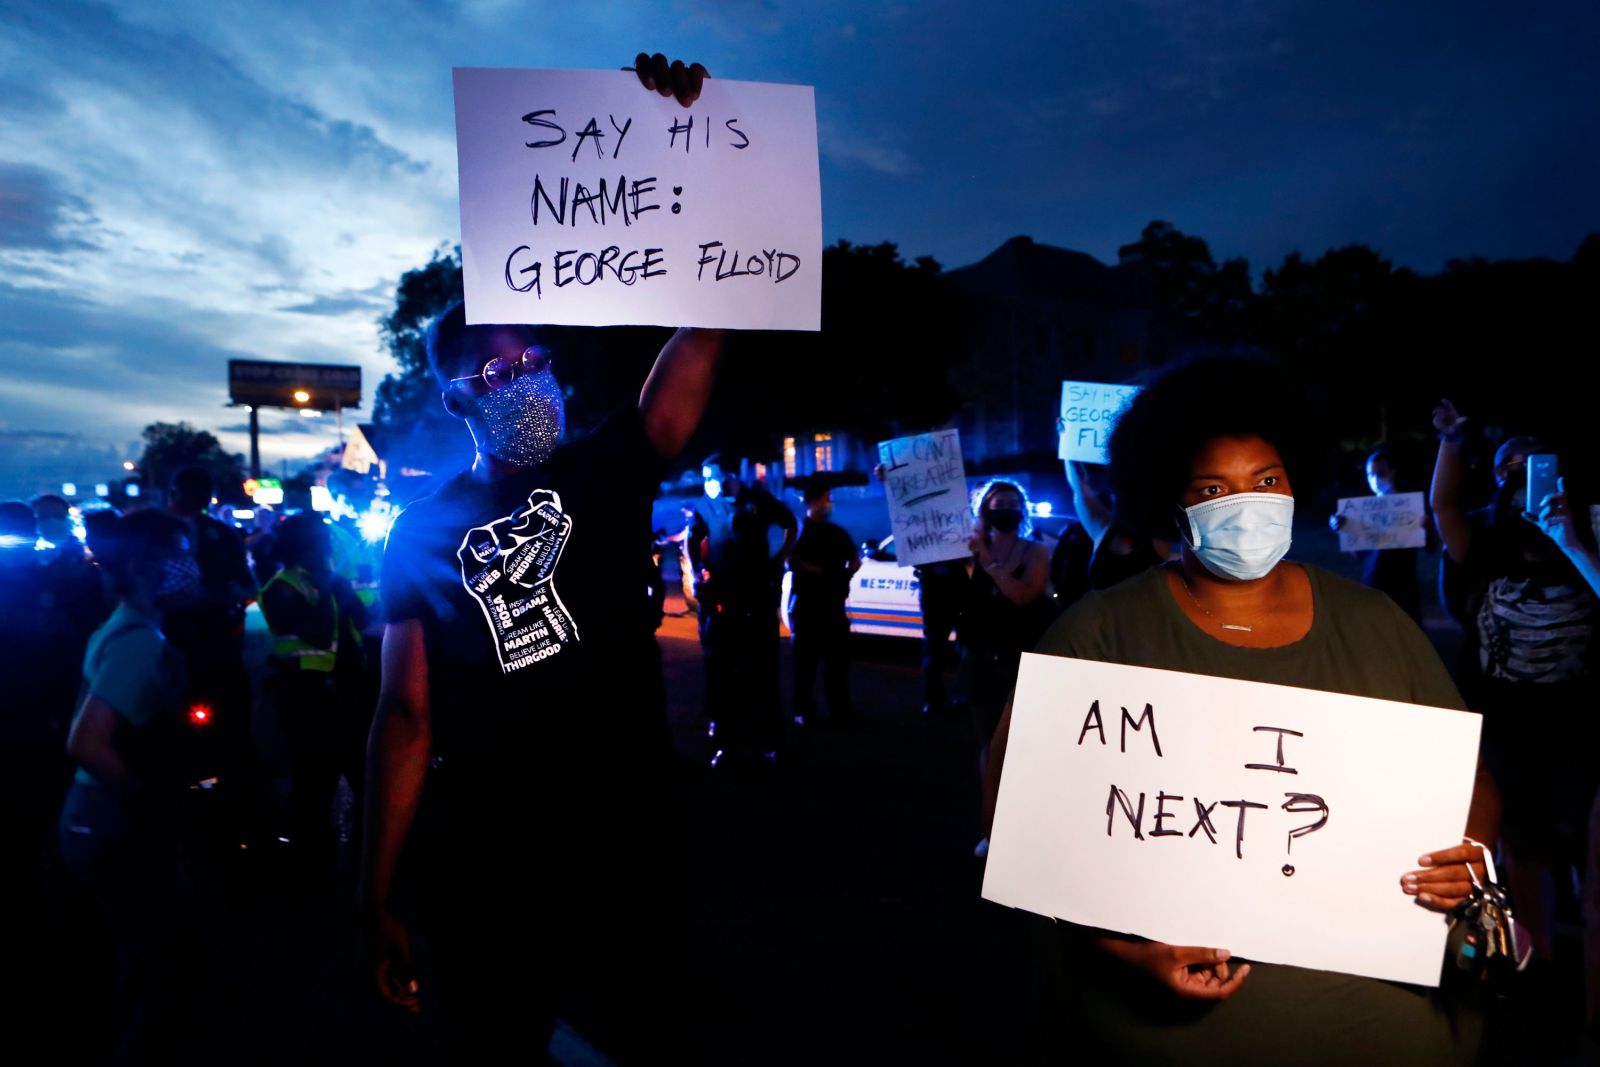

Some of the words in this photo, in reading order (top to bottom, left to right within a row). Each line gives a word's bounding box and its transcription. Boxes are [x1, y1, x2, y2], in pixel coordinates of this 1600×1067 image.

[522, 109, 632, 162] SAY
[667, 115, 750, 153] HIS
[531, 174, 683, 227] NAME:
[504, 245, 667, 300] GEORGE
[697, 240, 801, 284] FLLOYD
[1069, 385, 1097, 402] SAY
[1078, 428, 1104, 448] FL
[879, 443, 909, 472] I
[889, 463, 961, 499] BREATHE
[507, 554, 523, 574] SPEAK
[521, 543, 532, 557] LIKE
[509, 540, 543, 584] FREDRICK
[536, 546, 551, 566] BUILD
[475, 569, 501, 593] WEB
[532, 586, 546, 598] LIKE
[493, 594, 513, 629] ROSA
[512, 594, 548, 617] OBAMA
[552, 606, 565, 625] LEAD
[504, 627, 549, 651] MARTIN
[529, 619, 545, 632] LIKE
[504, 643, 561, 672] THURGOOD
[509, 644, 536, 660] BELIEVE
[536, 639, 551, 650] LIKE
[1077, 700, 1163, 757] AM
[1244, 725, 1304, 775] I
[1106, 784, 1330, 877] NEXT?
